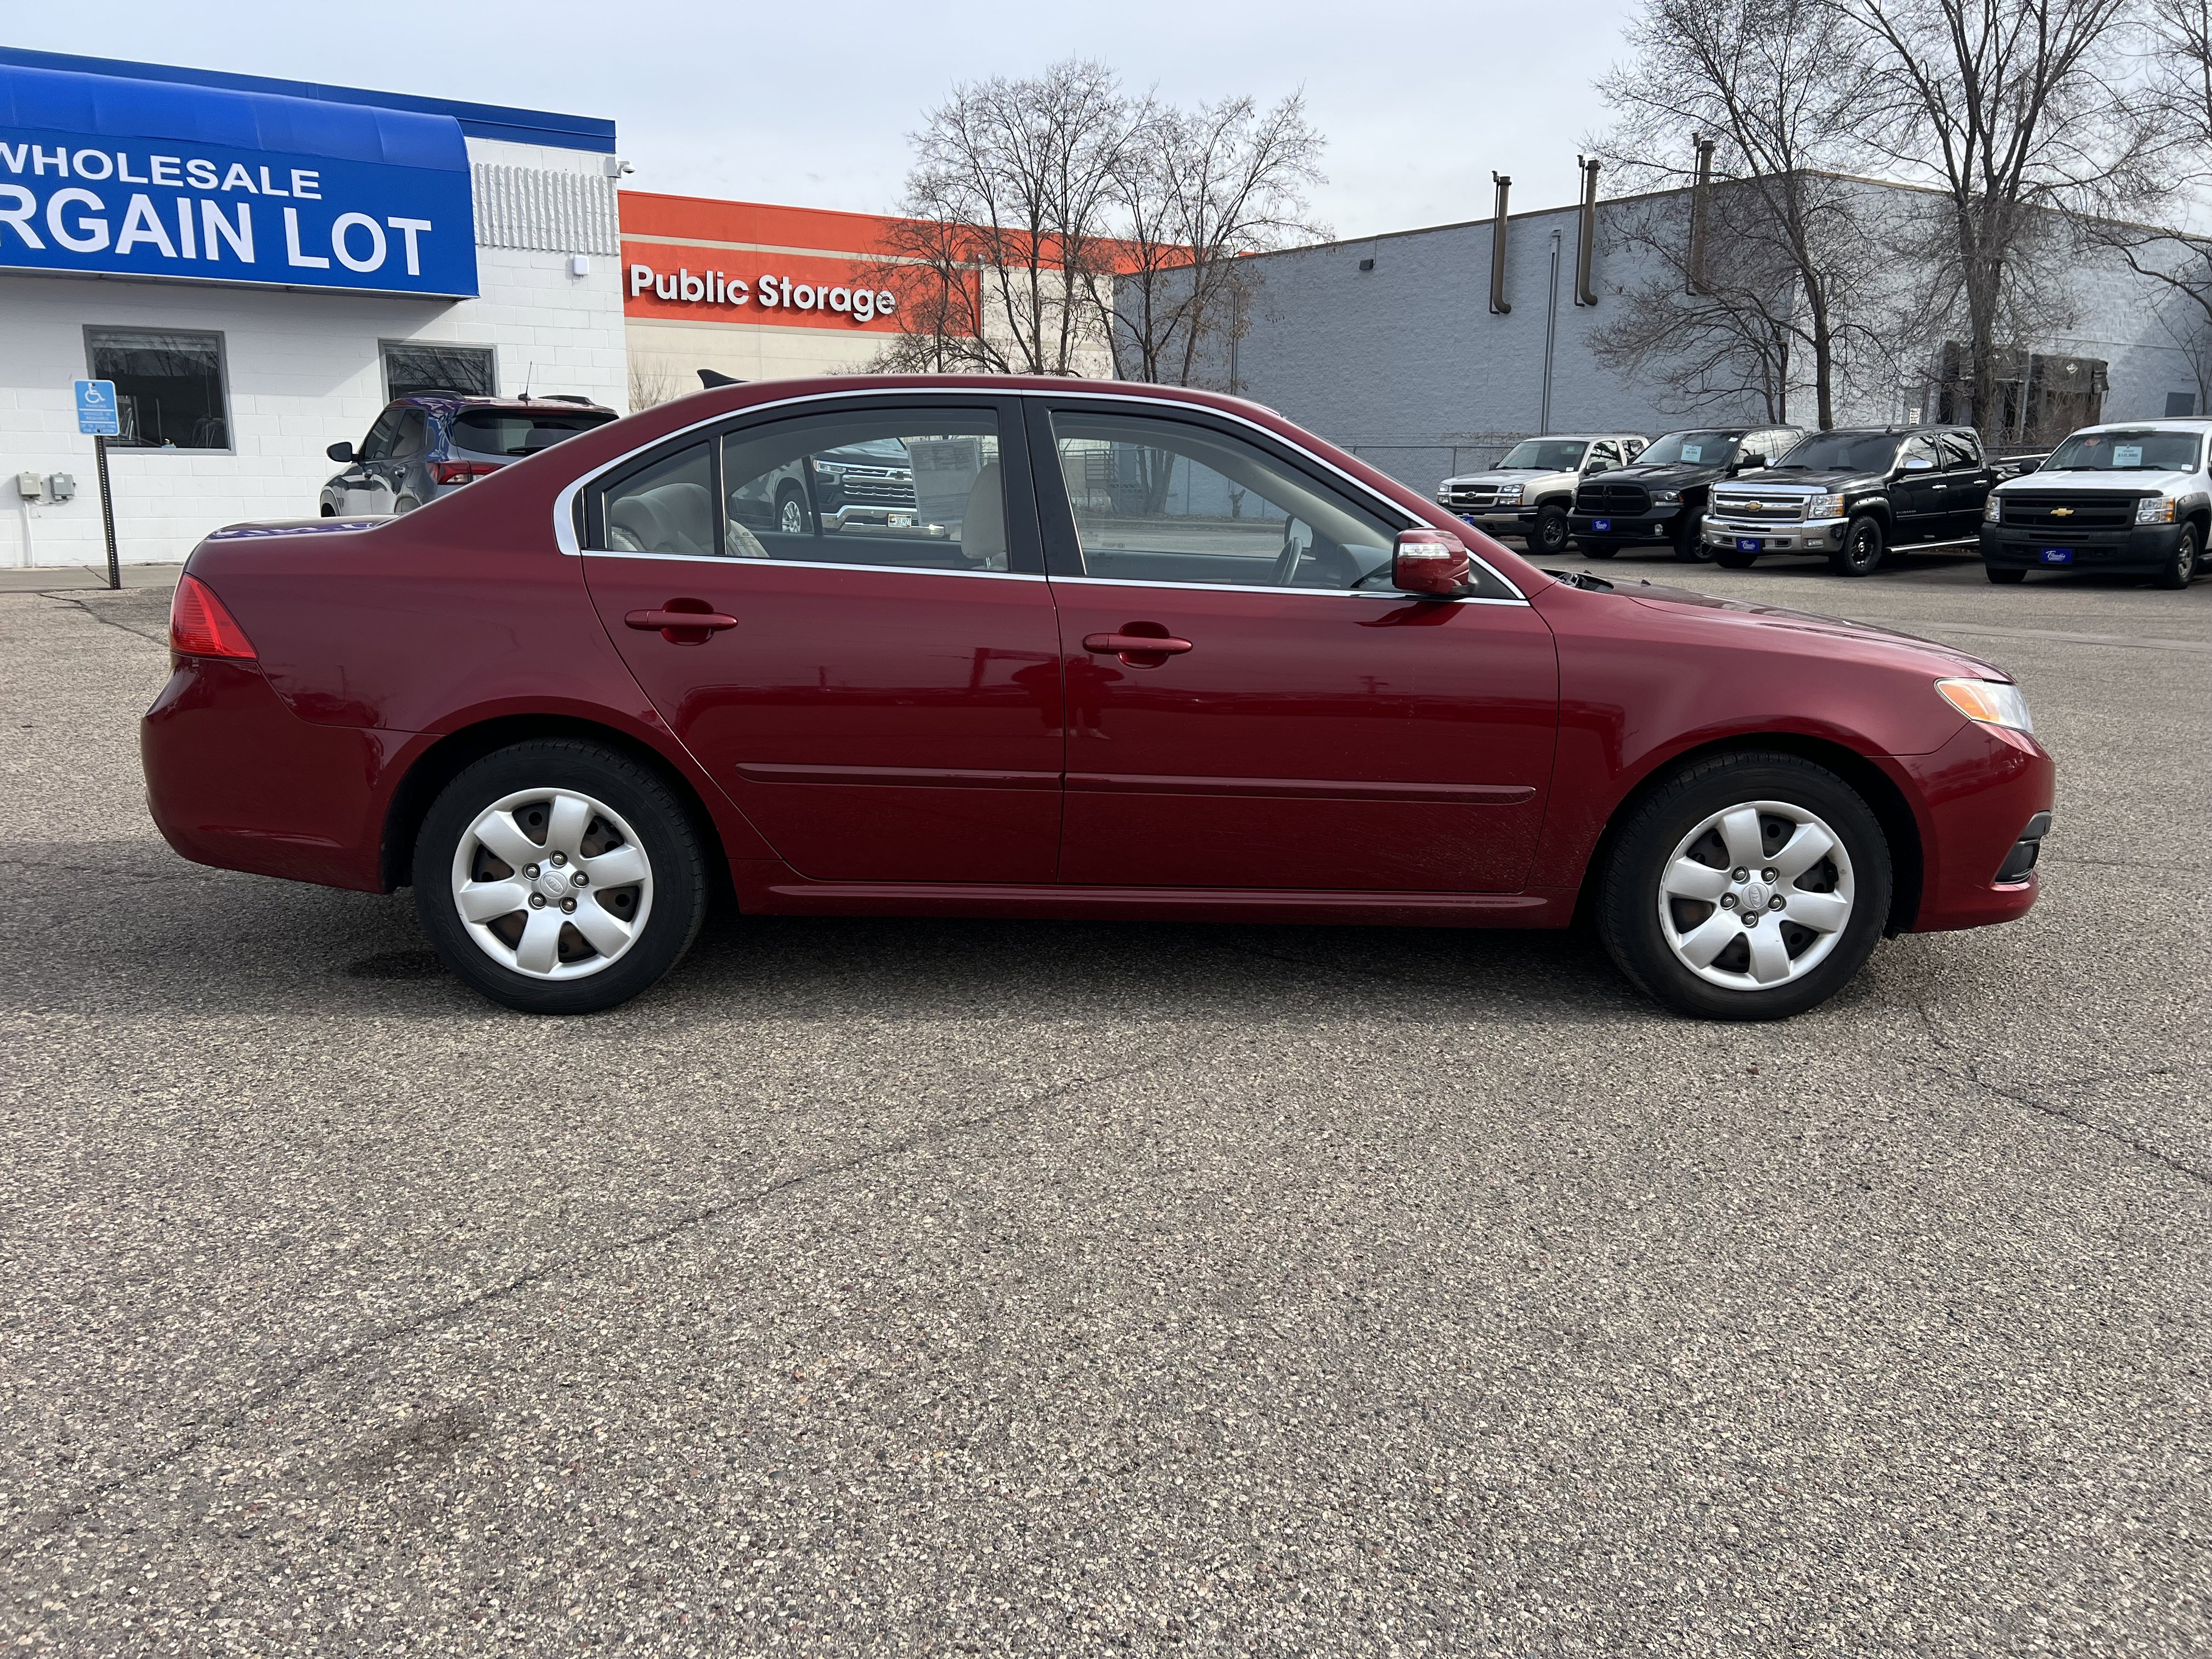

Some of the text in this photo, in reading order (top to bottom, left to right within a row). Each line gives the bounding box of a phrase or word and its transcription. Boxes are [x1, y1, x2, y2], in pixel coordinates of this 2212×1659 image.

[0, 142, 322, 200] WHOLESALE
[0, 183, 432, 276] RGAIN LOT
[630, 264, 896, 322] Public Storage
[546, 877, 563, 893] KIA
[1750, 887, 1761, 906] KIA
